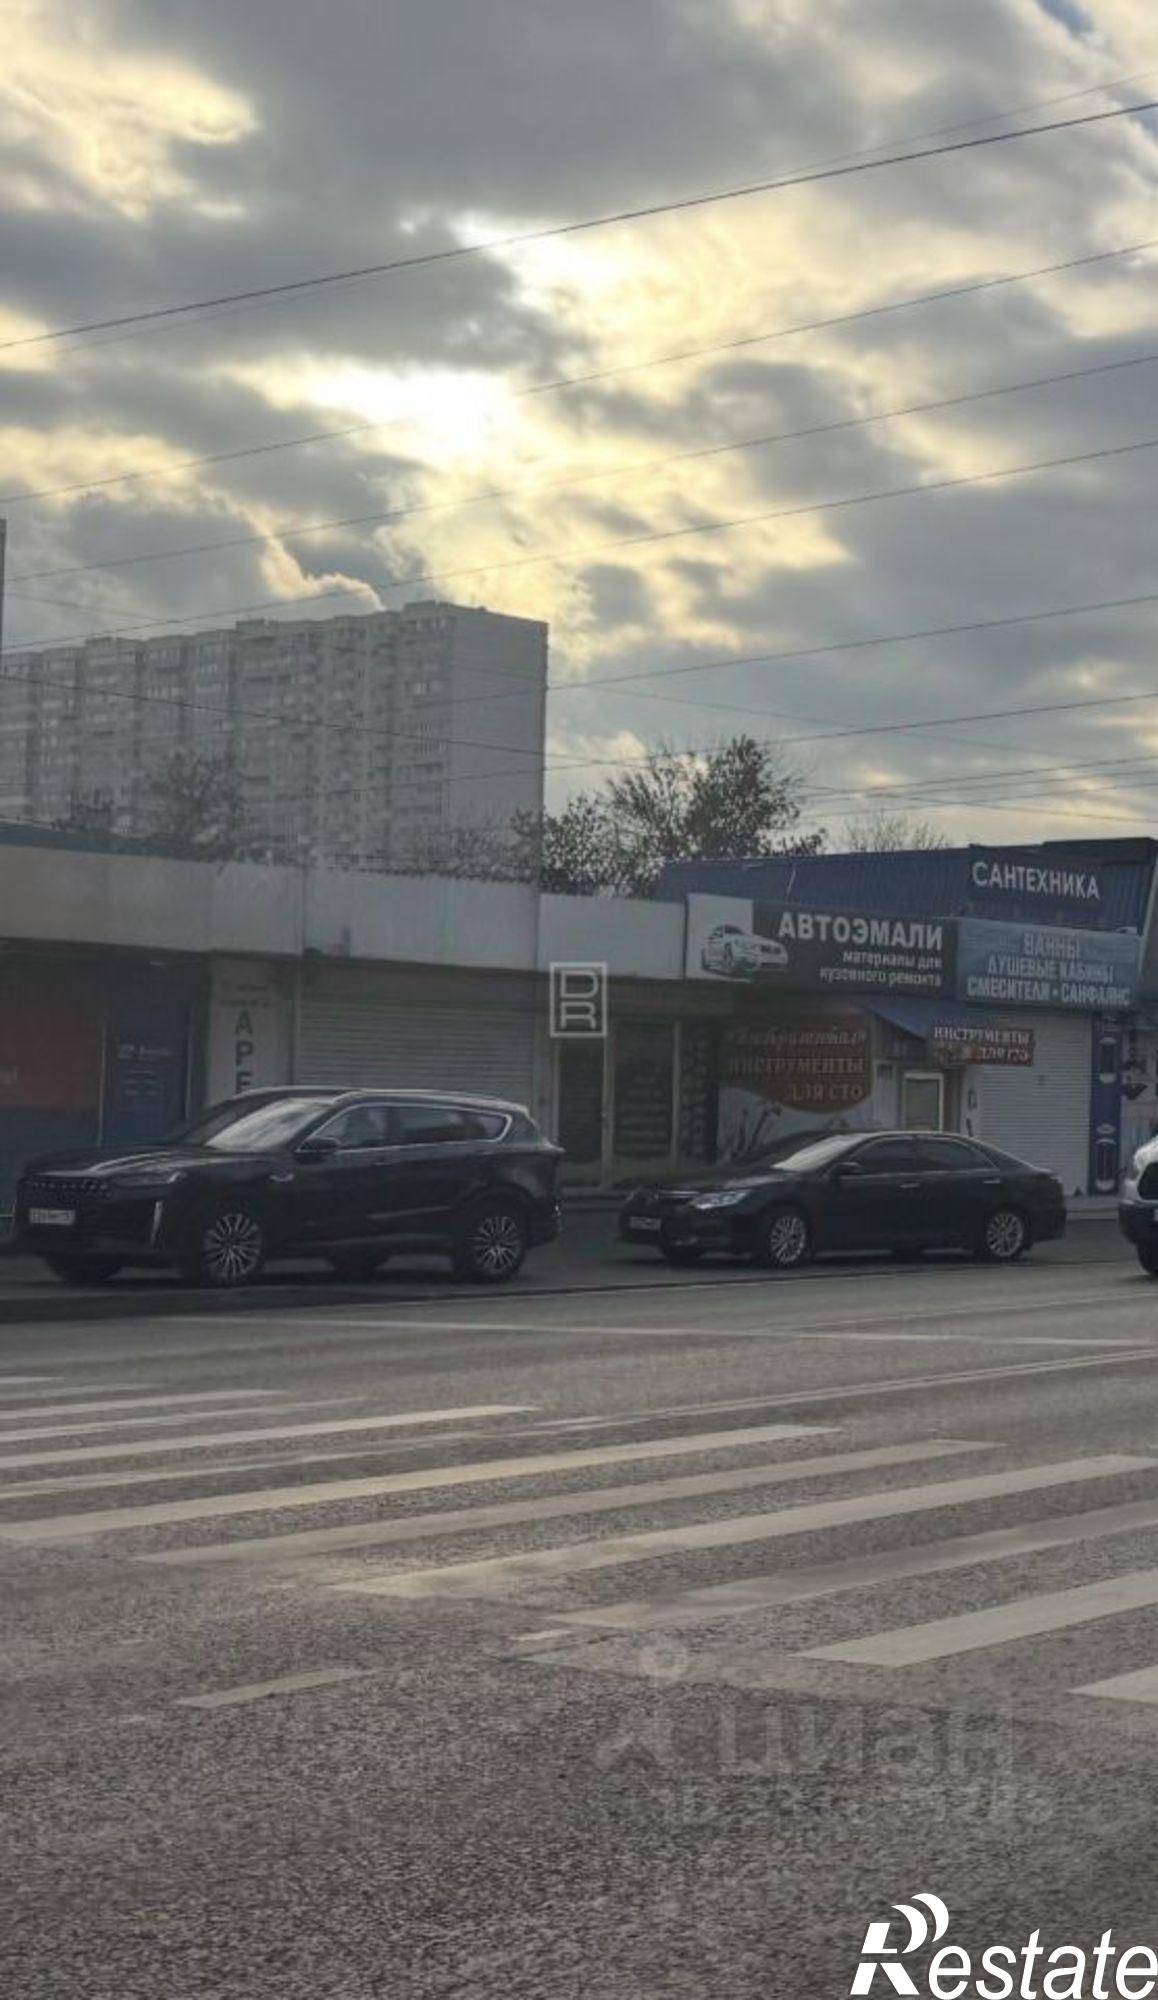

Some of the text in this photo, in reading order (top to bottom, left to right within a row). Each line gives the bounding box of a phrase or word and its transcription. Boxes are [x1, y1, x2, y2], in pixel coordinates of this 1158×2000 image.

[971, 860, 1100, 901] САНТЕХНИКА
[778, 912, 943, 951] АВТОЭМАЛИ
[1023, 931, 1081, 959] ВАННЫ
[843, 950, 942, 970] материалы для
[987, 953, 1114, 984] ДУШЕВЫЕ КАБИНЫ
[820, 966, 941, 988] кузовного ремонта
[967, 975, 1051, 1002] СМЕСИТЕЛИ
[933, 1026, 1031, 1045] ИНСТРУМЕНТЫ
[728, 1056, 865, 1075] ИНСТРУМЕНТЫ
[828, 1083, 864, 1101] СТО
